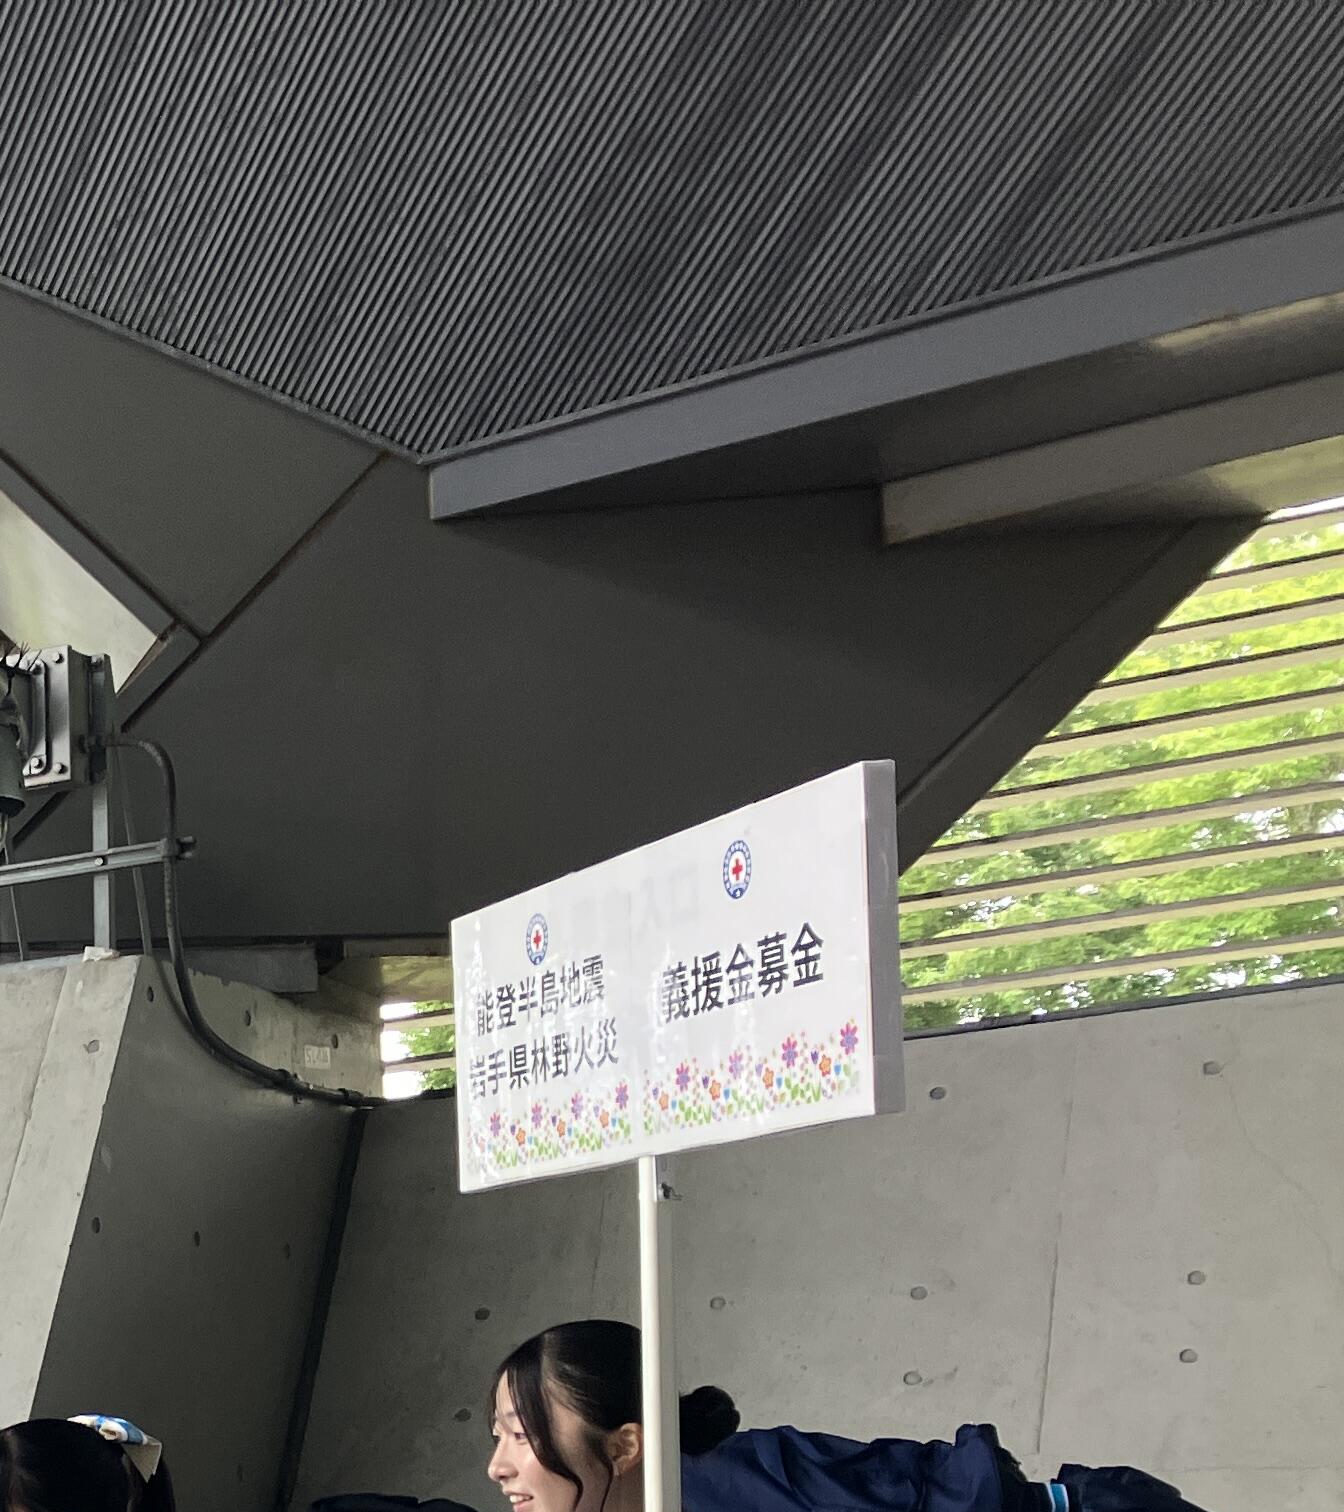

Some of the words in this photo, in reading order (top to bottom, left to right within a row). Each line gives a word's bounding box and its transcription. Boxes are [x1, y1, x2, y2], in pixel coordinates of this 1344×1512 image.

[477, 954, 605, 1037] 能登半島地震
[661, 922, 825, 1024] 義援金募金
[469, 1017, 620, 1101] 岩手県林野火災
